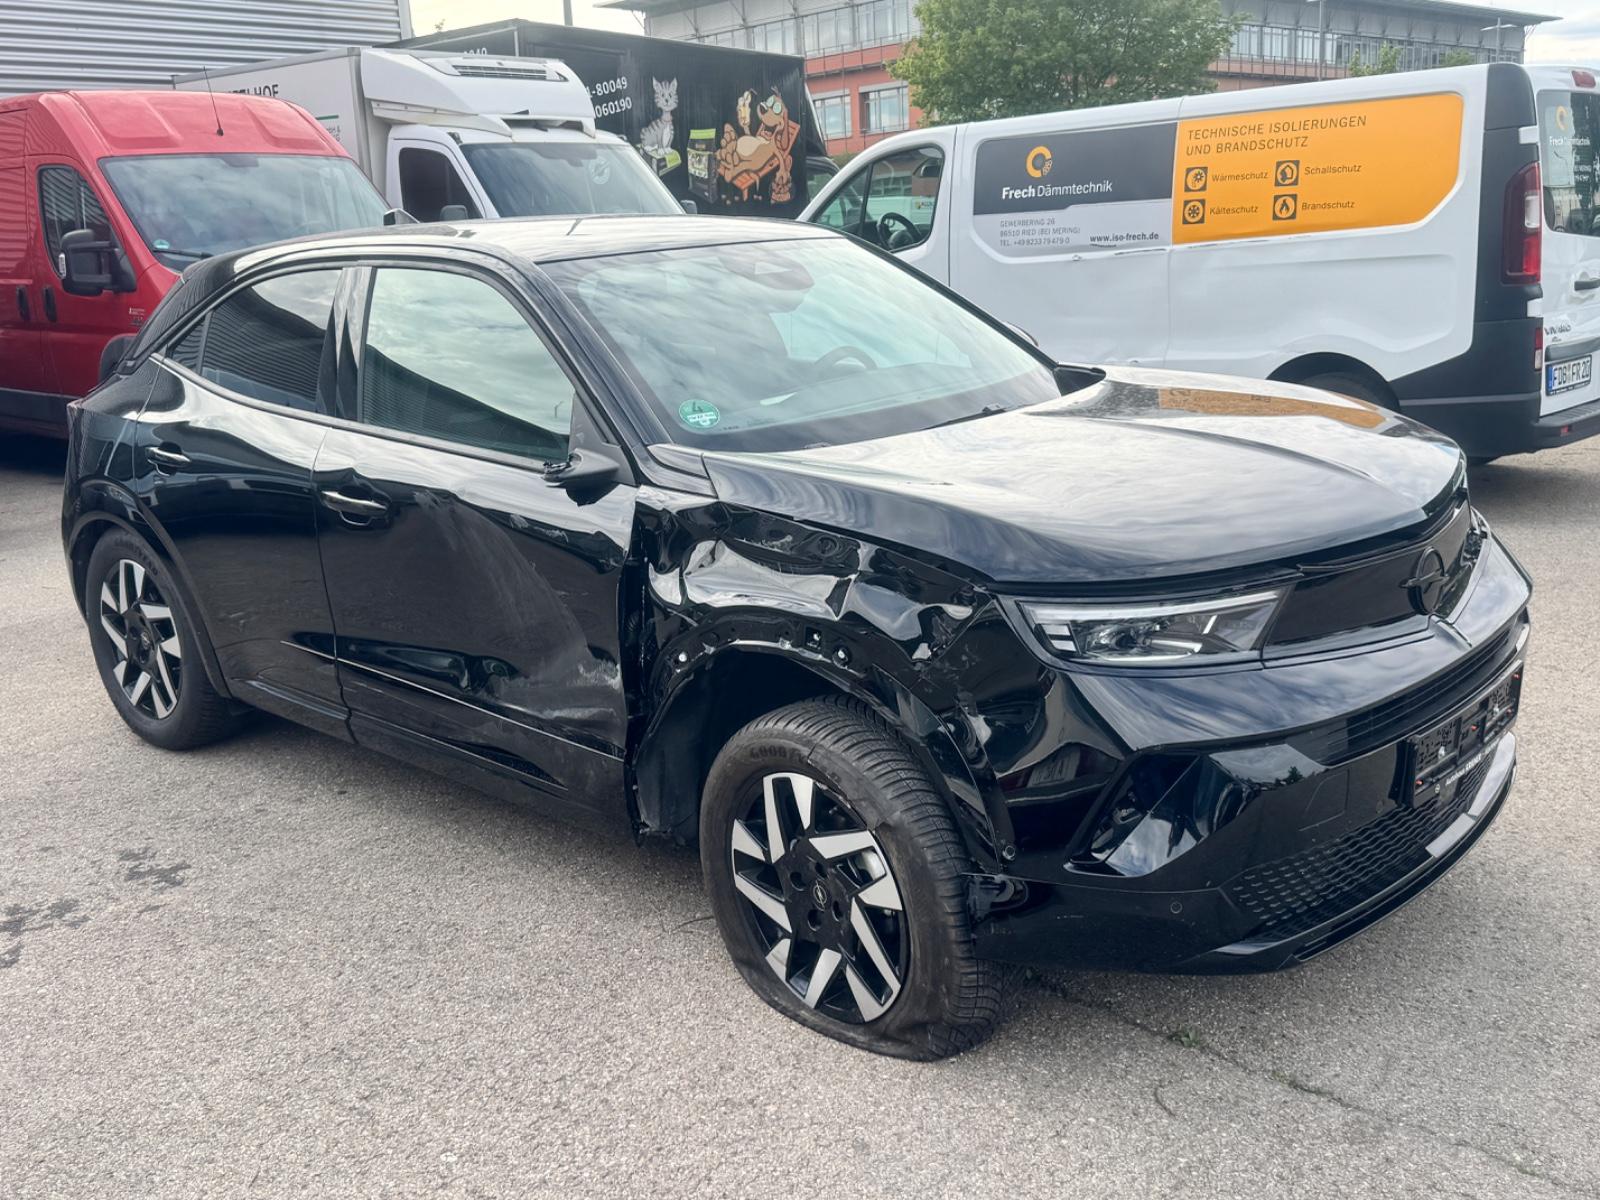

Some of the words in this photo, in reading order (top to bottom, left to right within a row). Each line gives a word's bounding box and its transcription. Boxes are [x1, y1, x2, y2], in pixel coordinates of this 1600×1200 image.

[595, 96, 632, 118] 060190
[1188, 123, 1264, 140] TECHNISCHE
[1269, 115, 1367, 133] ISOLIERUNGEN
[1186, 144, 1211, 156] UND
[1216, 136, 1309, 154] BRANDSCHUTZ
[1304, 165, 1362, 176] Schallschutz
[1211, 171, 1268, 182] Wärmeschutz
[1002, 185, 1035, 200] Frech
[1037, 180, 1113, 197] Dämmtechnik
[1209, 206, 1258, 216] Kälteschutz
[1301, 201, 1355, 211] Brandschutz
[1090, 232, 1159, 243] www.iso-frech.de
